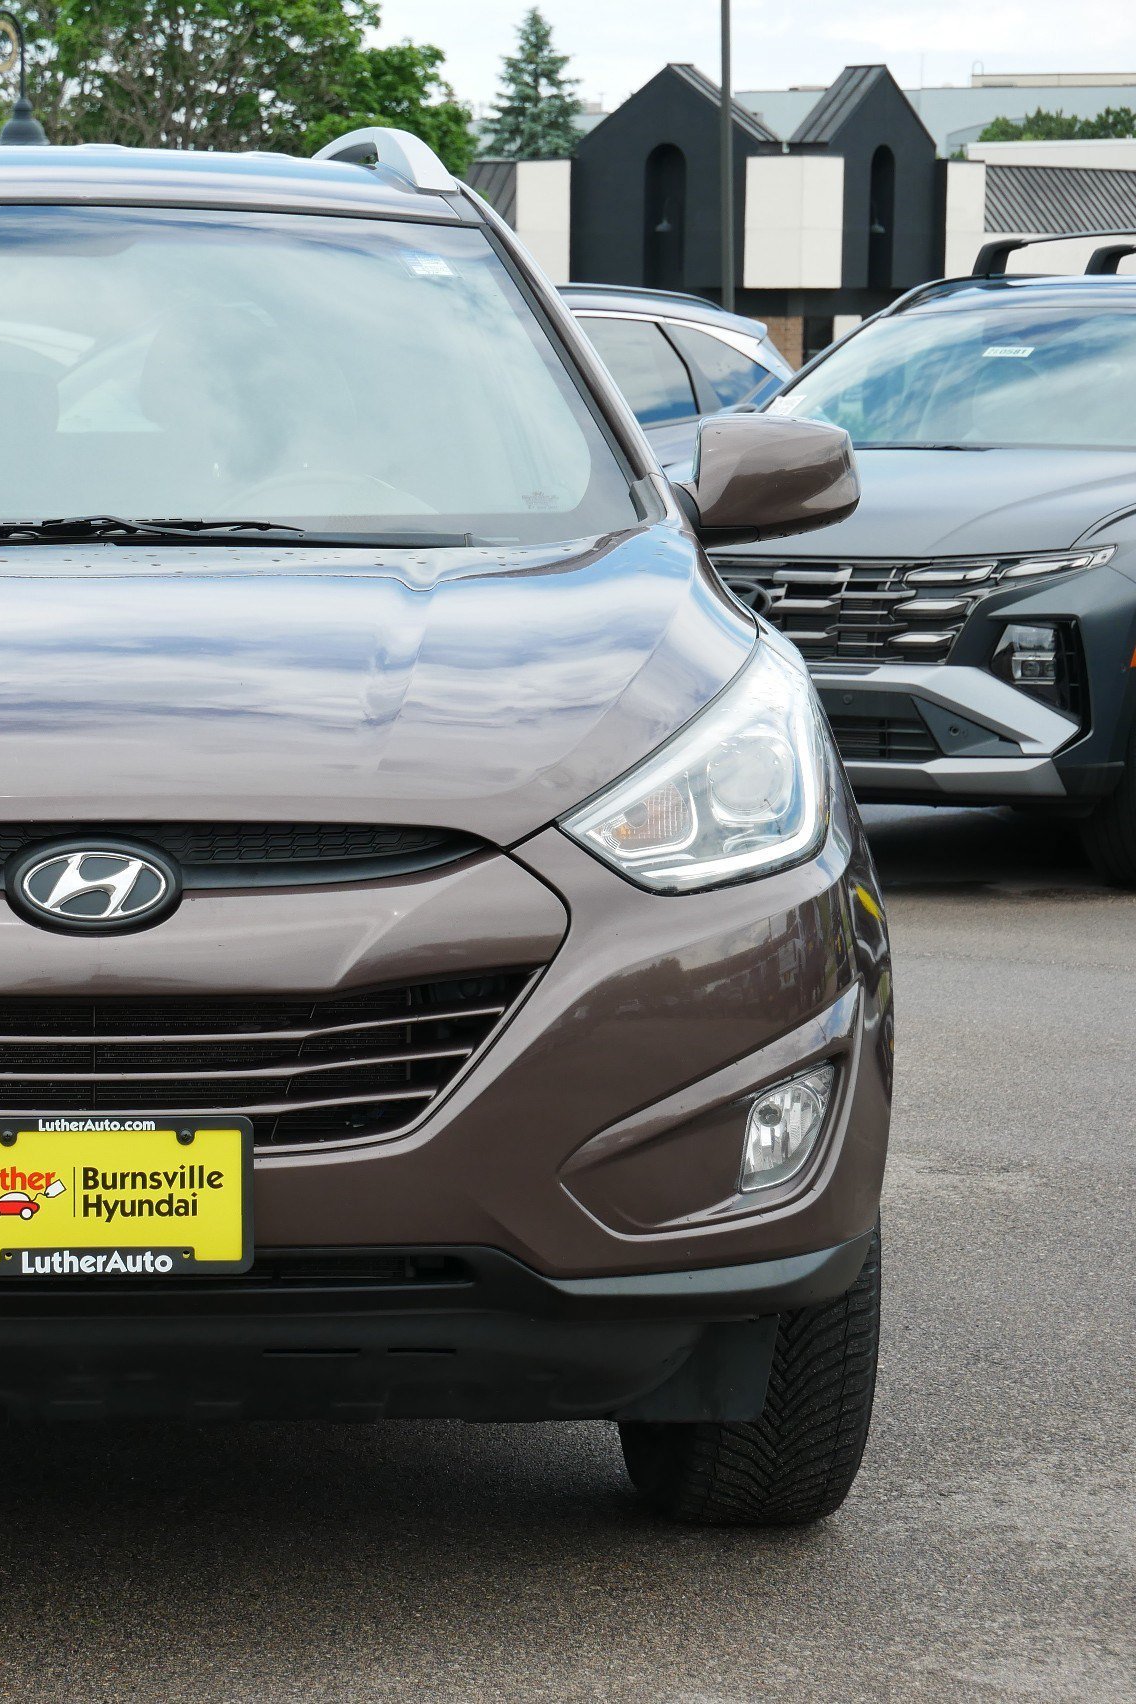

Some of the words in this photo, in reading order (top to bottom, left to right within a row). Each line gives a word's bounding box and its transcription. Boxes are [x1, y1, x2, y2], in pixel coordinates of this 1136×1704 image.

[38, 1119, 155, 1131] LutherAuto.com
[82, 1164, 224, 1190] Burnsville
[82, 1192, 198, 1222] Hyundai
[22, 1250, 173, 1273] LutherAuto
